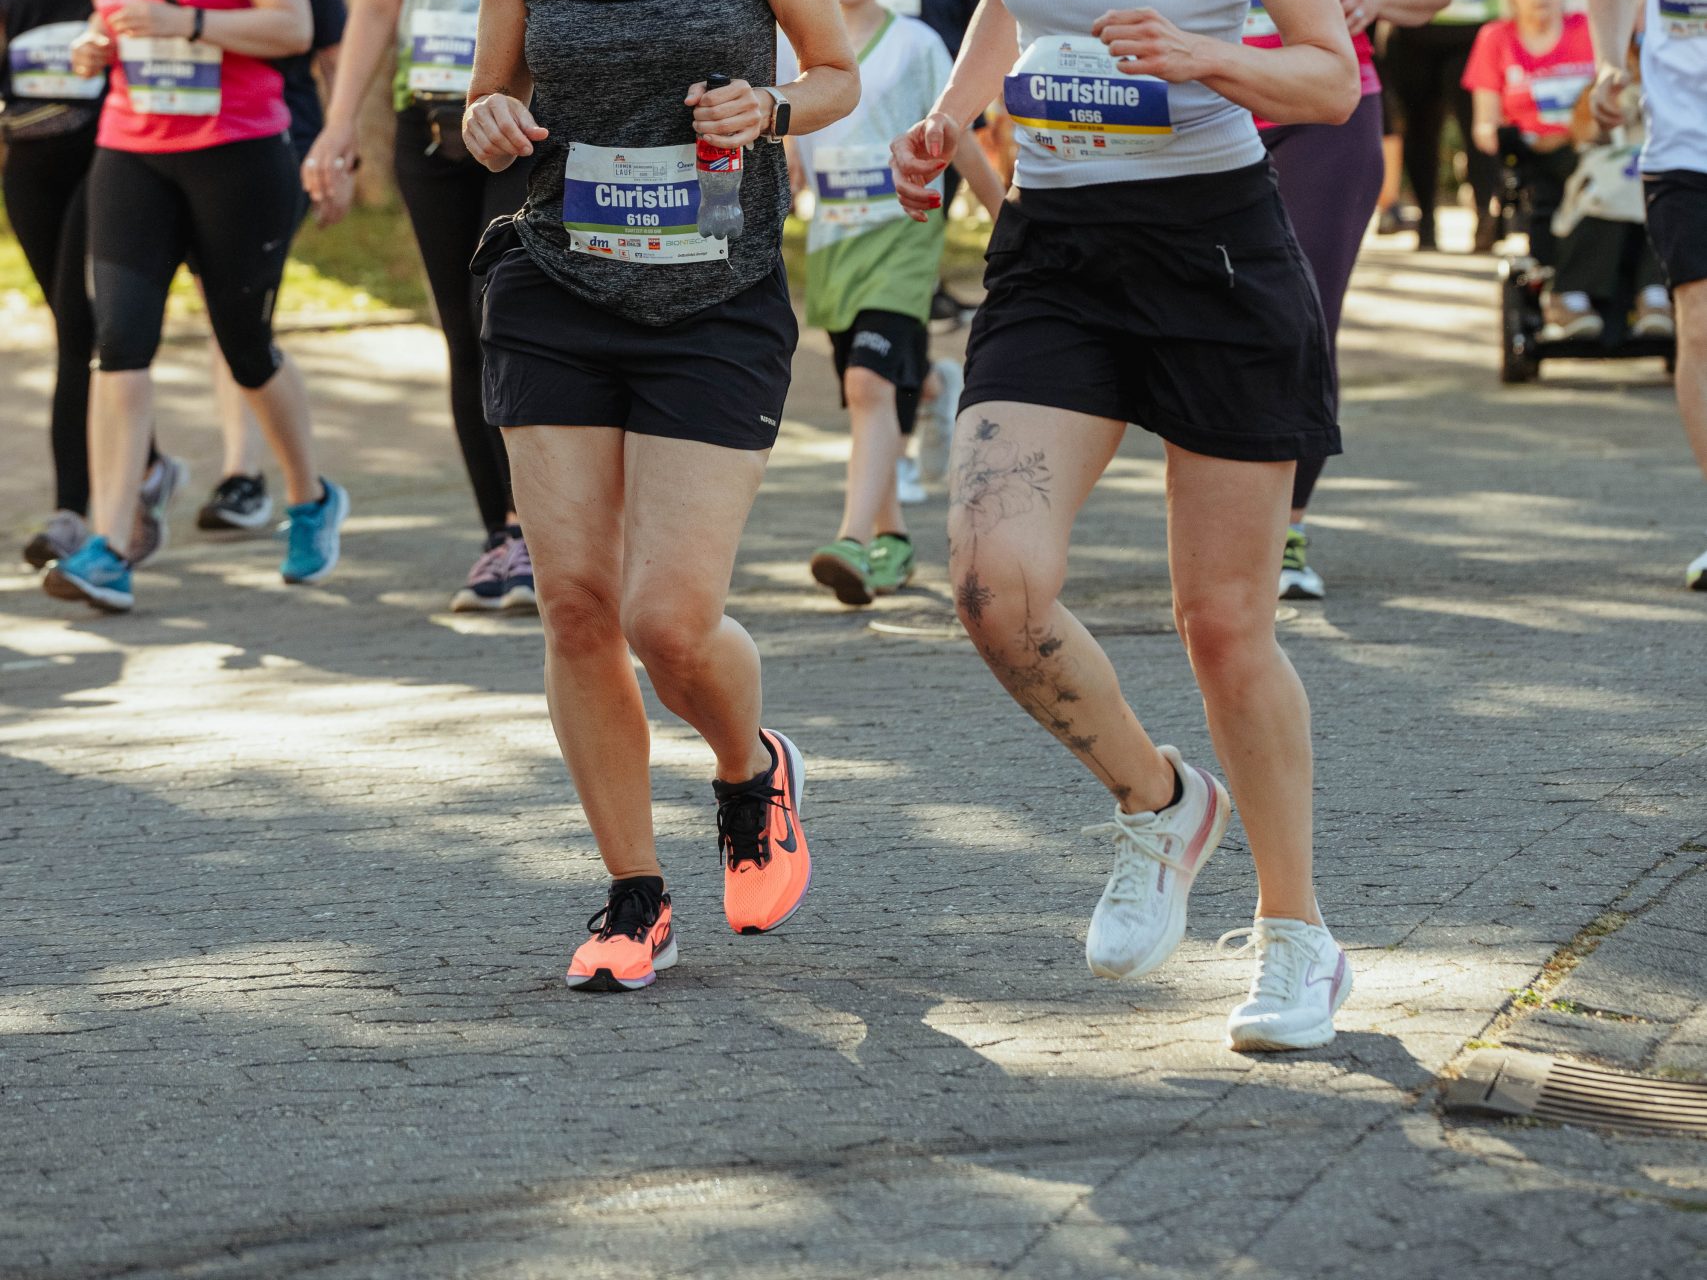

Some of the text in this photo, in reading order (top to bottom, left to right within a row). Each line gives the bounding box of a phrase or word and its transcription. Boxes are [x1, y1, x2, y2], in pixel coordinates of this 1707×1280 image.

[1029, 75, 1140, 107] Christine
[1069, 108, 1103, 123] 1656
[1035, 132, 1053, 146] dm
[595, 184, 689, 209] Christin
[626, 213, 660, 226] 6160
[589, 236, 609, 249] dm
